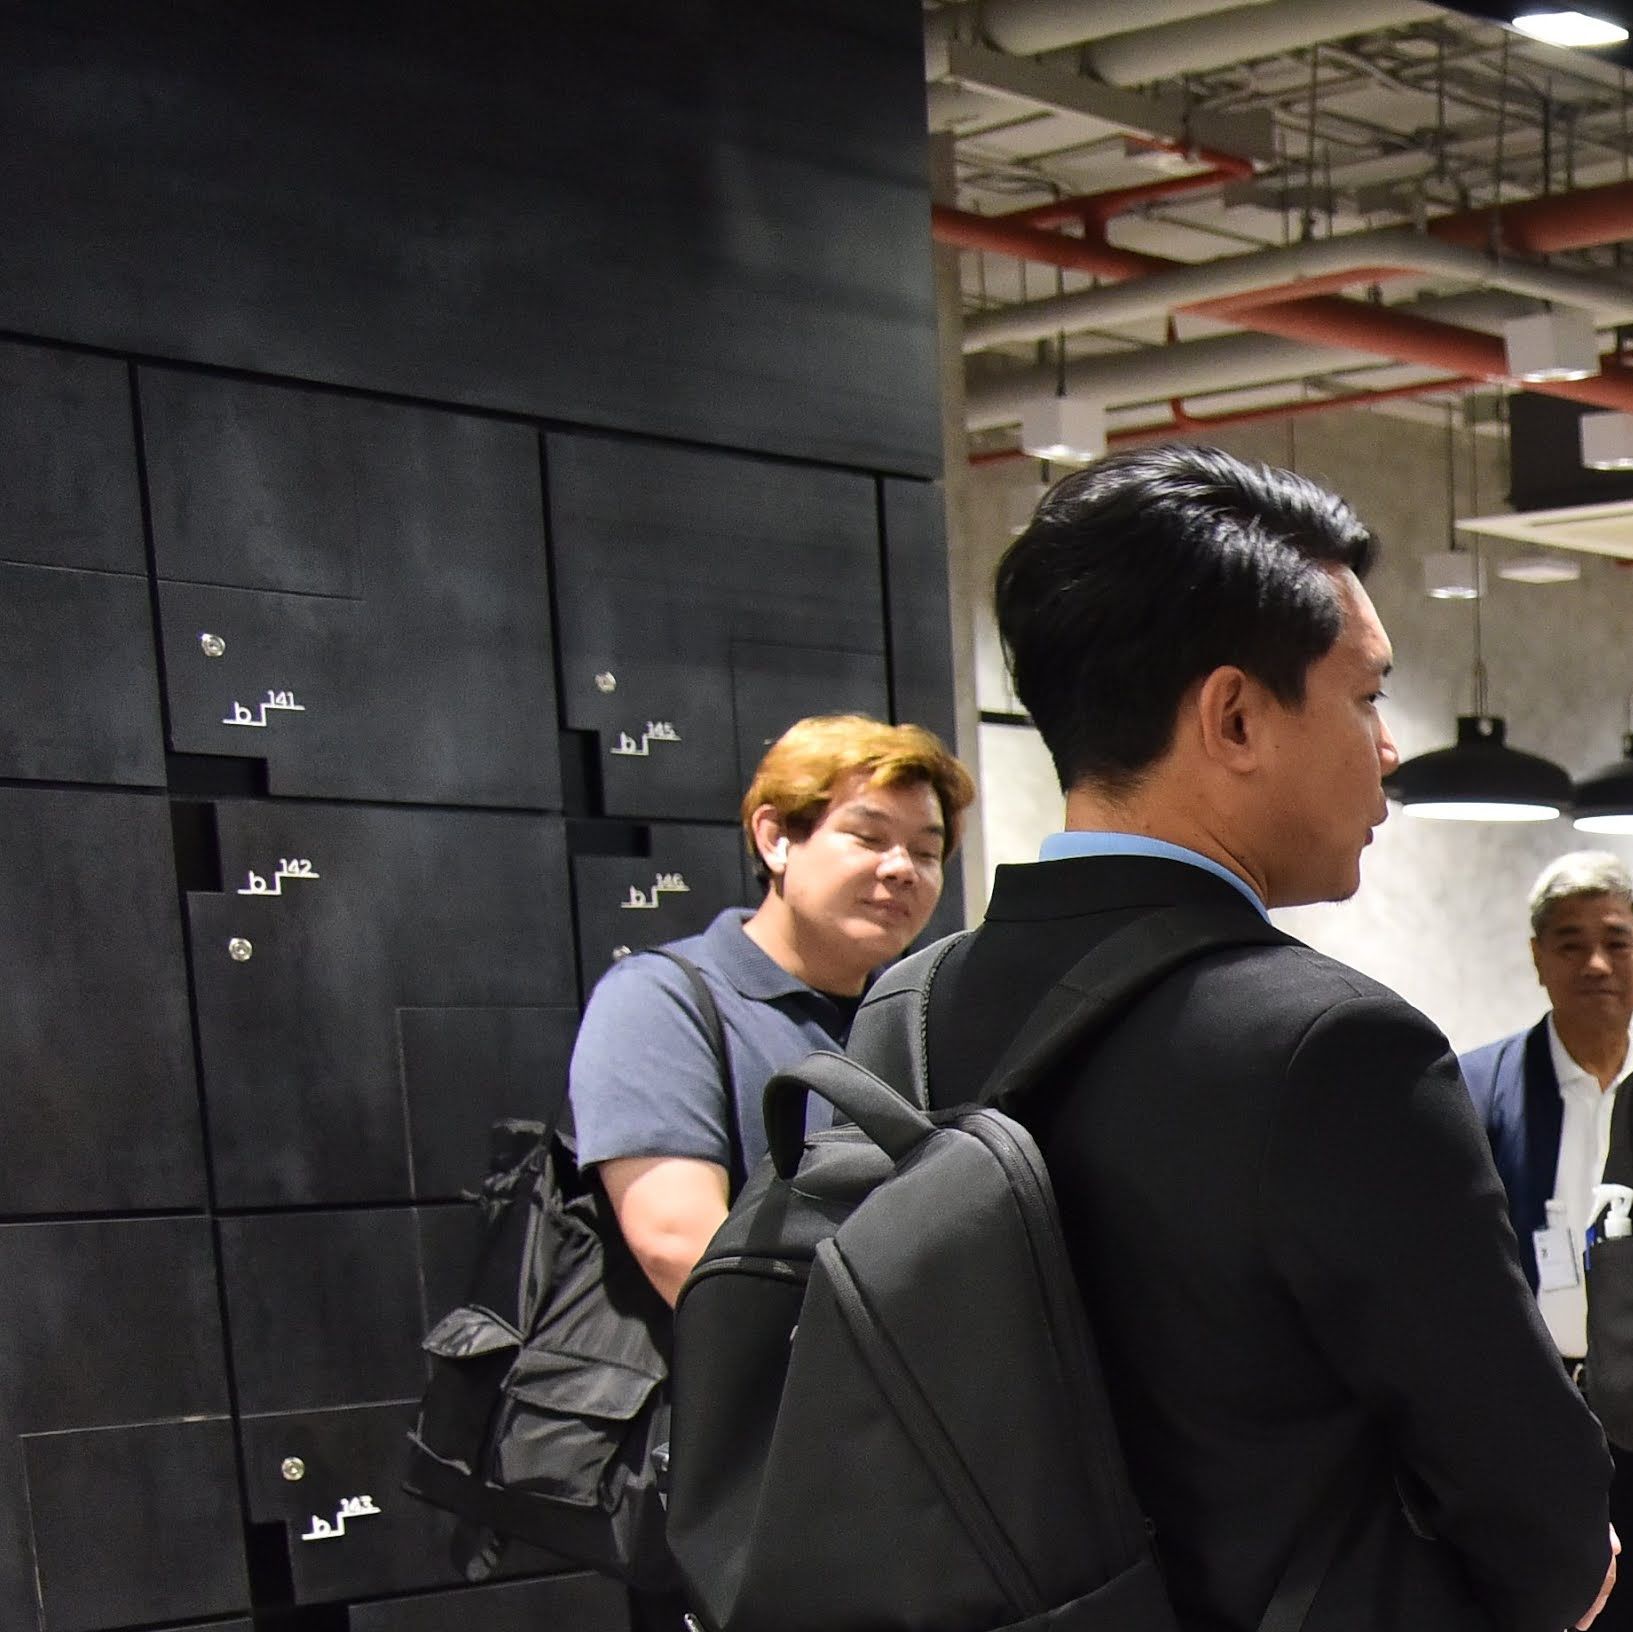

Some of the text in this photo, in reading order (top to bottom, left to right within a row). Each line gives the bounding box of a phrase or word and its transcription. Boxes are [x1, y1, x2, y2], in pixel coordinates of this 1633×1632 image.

[234, 690, 295, 723] b 141
[620, 721, 676, 753] b 145
[249, 858, 313, 892] b 142
[629, 885, 647, 905] b
[311, 1515, 332, 1536] b
